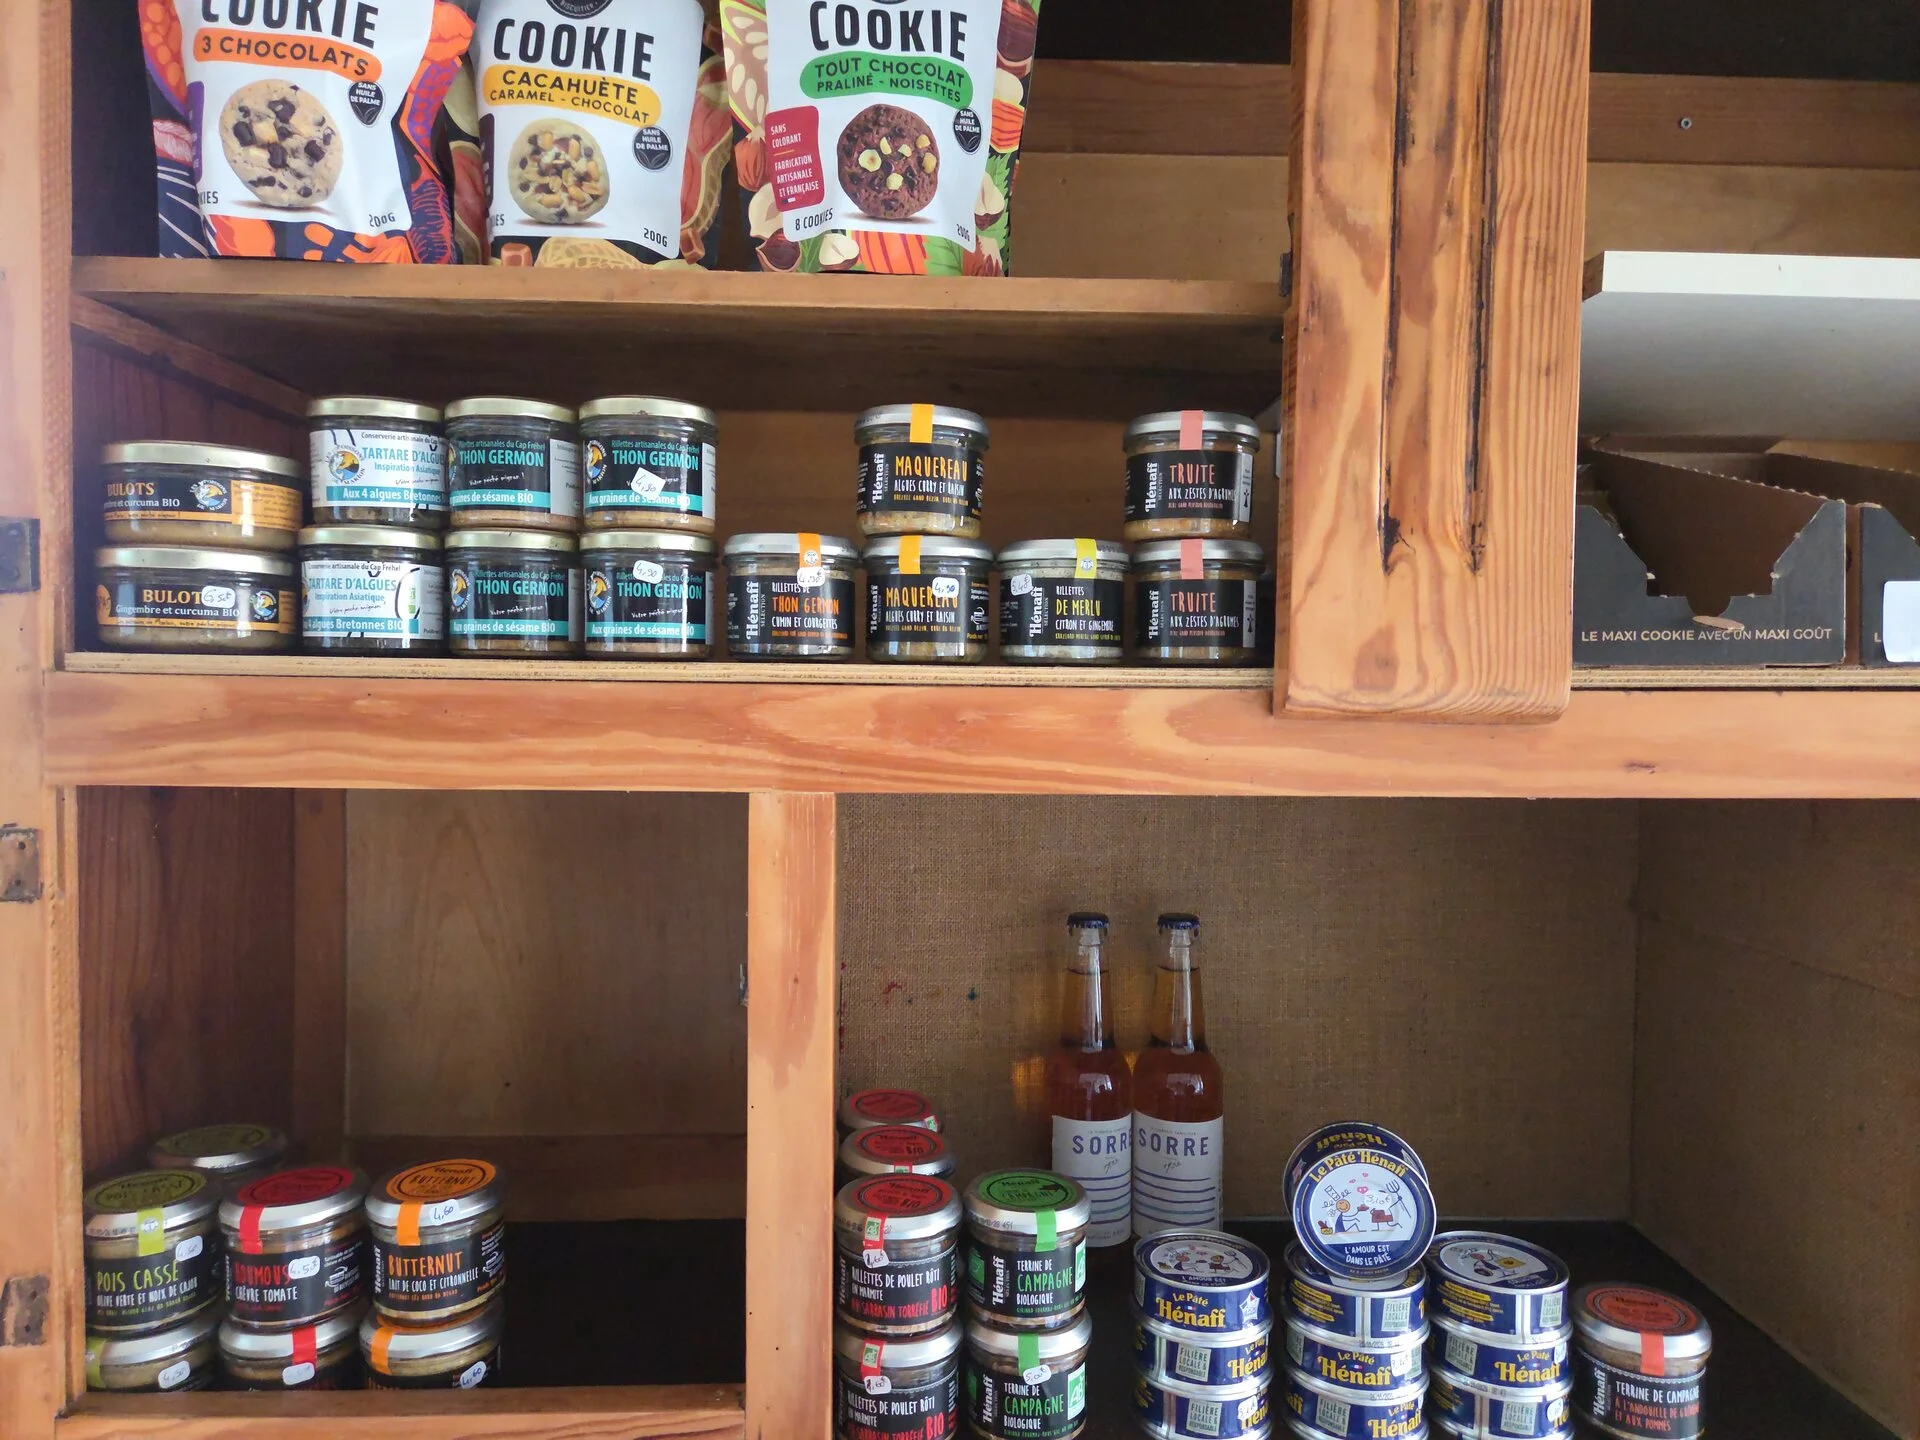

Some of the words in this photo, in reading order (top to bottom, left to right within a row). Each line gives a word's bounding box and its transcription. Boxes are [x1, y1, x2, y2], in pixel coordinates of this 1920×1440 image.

[202, 0, 378, 49] COOKIE
[809, 0, 968, 62] COOKIE
[202, 36, 212, 53] 3
[220, 36, 369, 77] CHOCOLATS
[494, 18, 654, 81] COOKIE
[814, 58, 862, 79] TOUT
[869, 58, 965, 88] CHOCOLAT
[502, 70, 638, 105] CACAHUÈTE
[816, 72, 873, 93] PRALINÉ
[889, 78, 961, 103] NOISETTES
[490, 90, 553, 102] CARAMEL
[571, 97, 650, 124] CHOCOLAT
[641, 136, 661, 144] HUILE
[642, 128, 661, 136] SANS
[770, 124, 787, 136] SANS
[635, 143, 645, 151] DE
[646, 143, 669, 152] PALME
[772, 132, 802, 149] COLORANT
[774, 154, 813, 171] FABRICATION
[776, 168, 813, 185] ARTISANALE
[779, 186, 787, 197] ET
[787, 180, 819, 196] FRANÇAISE
[795, 218, 801, 231] 8
[803, 208, 834, 230] COOKIES
[643, 228, 668, 248] 200G
[459, 449, 486, 465] THON
[488, 449, 544, 467] GERMON
[611, 450, 646, 465] THON
[649, 450, 699, 471] GERMON
[872, 453, 885, 504] Hénaff
[895, 455, 968, 482] MAQUEREAU
[1169, 463, 1215, 485] TRUITE
[107, 482, 156, 497] BULOTS
[343, 487, 360, 499] Aux
[361, 488, 368, 499] 4
[370, 488, 402, 503] algues
[403, 489, 441, 503] Bretonnes
[1145, 462, 1158, 513] Hénaff
[588, 494, 599, 505] Aux
[599, 493, 627, 506] graines
[628, 492, 640, 503] de
[309, 577, 343, 590] TARTARE
[345, 577, 397, 592] D'ALGUES
[475, 579, 510, 595] THON
[512, 580, 564, 597] GERMON
[616, 582, 652, 598] THON
[1056, 585, 1086, 596] RILLETTES
[314, 592, 348, 602] Inspiration
[349, 592, 385, 604] Asiatique
[772, 595, 799, 613] THON
[803, 597, 840, 615] GERMON
[1055, 598, 1069, 616] DE
[1071, 599, 1101, 617] MERLU
[1169, 591, 1217, 613] TRUITE
[116, 604, 161, 615] Gingembre
[162, 606, 173, 615] et
[174, 607, 219, 617] curcuma
[222, 607, 239, 617] BIO
[745, 580, 759, 640] Hénaff
[870, 584, 879, 634] Hénaff
[1029, 586, 1043, 638] Hénaff
[1148, 589, 1160, 640] Hénaff
[591, 624, 603, 635] Aux
[603, 624, 632, 636] graines
[634, 623, 646, 635] de
[647, 624, 680, 636] sésame
[771, 616, 792, 628] CUMIN
[794, 616, 802, 628] ET
[803, 617, 838, 630] COURGETTES
[1055, 618, 1078, 631] CITRON
[1079, 619, 1087, 631] ET
[1169, 615, 1183, 628] AUX
[1185, 615, 1208, 628] ZESTES
[1209, 615, 1240, 628] D'AGRUMES
[1581, 631, 1598, 642] LE
[1602, 630, 1637, 642] MAXI
[1641, 629, 1695, 642] COOKIE
[1697, 629, 1730, 641] AVEC
[1733, 629, 1752, 641] UN
[1755, 629, 1790, 640] MAXI
[1793, 626, 1832, 641] GOÛT
[1138, 1127, 1209, 1157] SORRE
[1308, 1166, 1327, 1183] Le
[1325, 1151, 1357, 1171] Pâté
[1357, 1149, 1408, 1178] Hénaff
[1344, 1244, 1377, 1254] L'AMOUR
[1377, 1244, 1390, 1252] EST
[1345, 1254, 1364, 1266] DANS
[1364, 1257, 1373, 1266] LE
[1374, 1251, 1392, 1265] PÂTÉ
[234, 1262, 292, 1286] HOUMOUS
[387, 1251, 463, 1278] BUTTERNUT
[1016, 1259, 1043, 1272] TERRINE
[1044, 1259, 1053, 1271] DE
[388, 1277, 401, 1291] LAIT
[402, 1278, 410, 1292] DE
[411, 1278, 427, 1292] COCO
[429, 1278, 437, 1292] ET
[439, 1266, 479, 1289] CITRONNELLE
[851, 1265, 883, 1288] RILLETTES
[885, 1273, 895, 1289] DE
[897, 1272, 924, 1289] POULET
[925, 1267, 940, 1285] RÔTI
[992, 1255, 1005, 1306] Hénaff
[1017, 1266, 1073, 1292] CAMPAGNE
[235, 1285, 260, 1303] CHÈVRE
[263, 1286, 298, 1302] TOMATE
[931, 1284, 948, 1313] BIO
[1016, 1293, 1054, 1305] BIOLOGIQUE
[1172, 1292, 1185, 1302] Le
[1186, 1292, 1209, 1307] Pâté
[1155, 1296, 1226, 1328] Hénaff
[1385, 1301, 1410, 1312] FILIÈRE
[1180, 1347, 1208, 1362] FILIÈRE
[1337, 1351, 1351, 1361] Le
[1352, 1351, 1375, 1365] Pâté
[1517, 1352, 1530, 1362] Le
[1531, 1349, 1550, 1361] Pâté
[1316, 1355, 1392, 1386] Hénaff
[1494, 1360, 1560, 1383] Hénaff
[982, 1374, 993, 1424] Hénaff
[1003, 1382, 1030, 1396] TERRINE
[1031, 1384, 1040, 1396] DE
[1592, 1367, 1605, 1416] Hénaff
[1615, 1380, 1650, 1402] TERRINE
[1652, 1388, 1664, 1404] DE
[1666, 1384, 1700, 1404] CAMPAGNE
[847, 1390, 878, 1414] RILLETTES
[879, 1400, 889, 1415] DE
[891, 1401, 918, 1416] POULET
[920, 1396, 935, 1413] RÔTI
[1004, 1394, 1065, 1416] CAMPAGNE
[1190, 1402, 1219, 1416] FILIÈRE
[1623, 1400, 1668, 1419] L'ANDOUILLE
[1669, 1406, 1677, 1419] DE
[925, 1411, 945, 1440] BIO
[1003, 1415, 1042, 1430] BIOLOGIQUE
[1367, 1409, 1421, 1439] Hénaff
[1615, 1410, 1623, 1422] ET
[1625, 1413, 1642, 1427] AUX
[1645, 1416, 1672, 1432] POMMES
